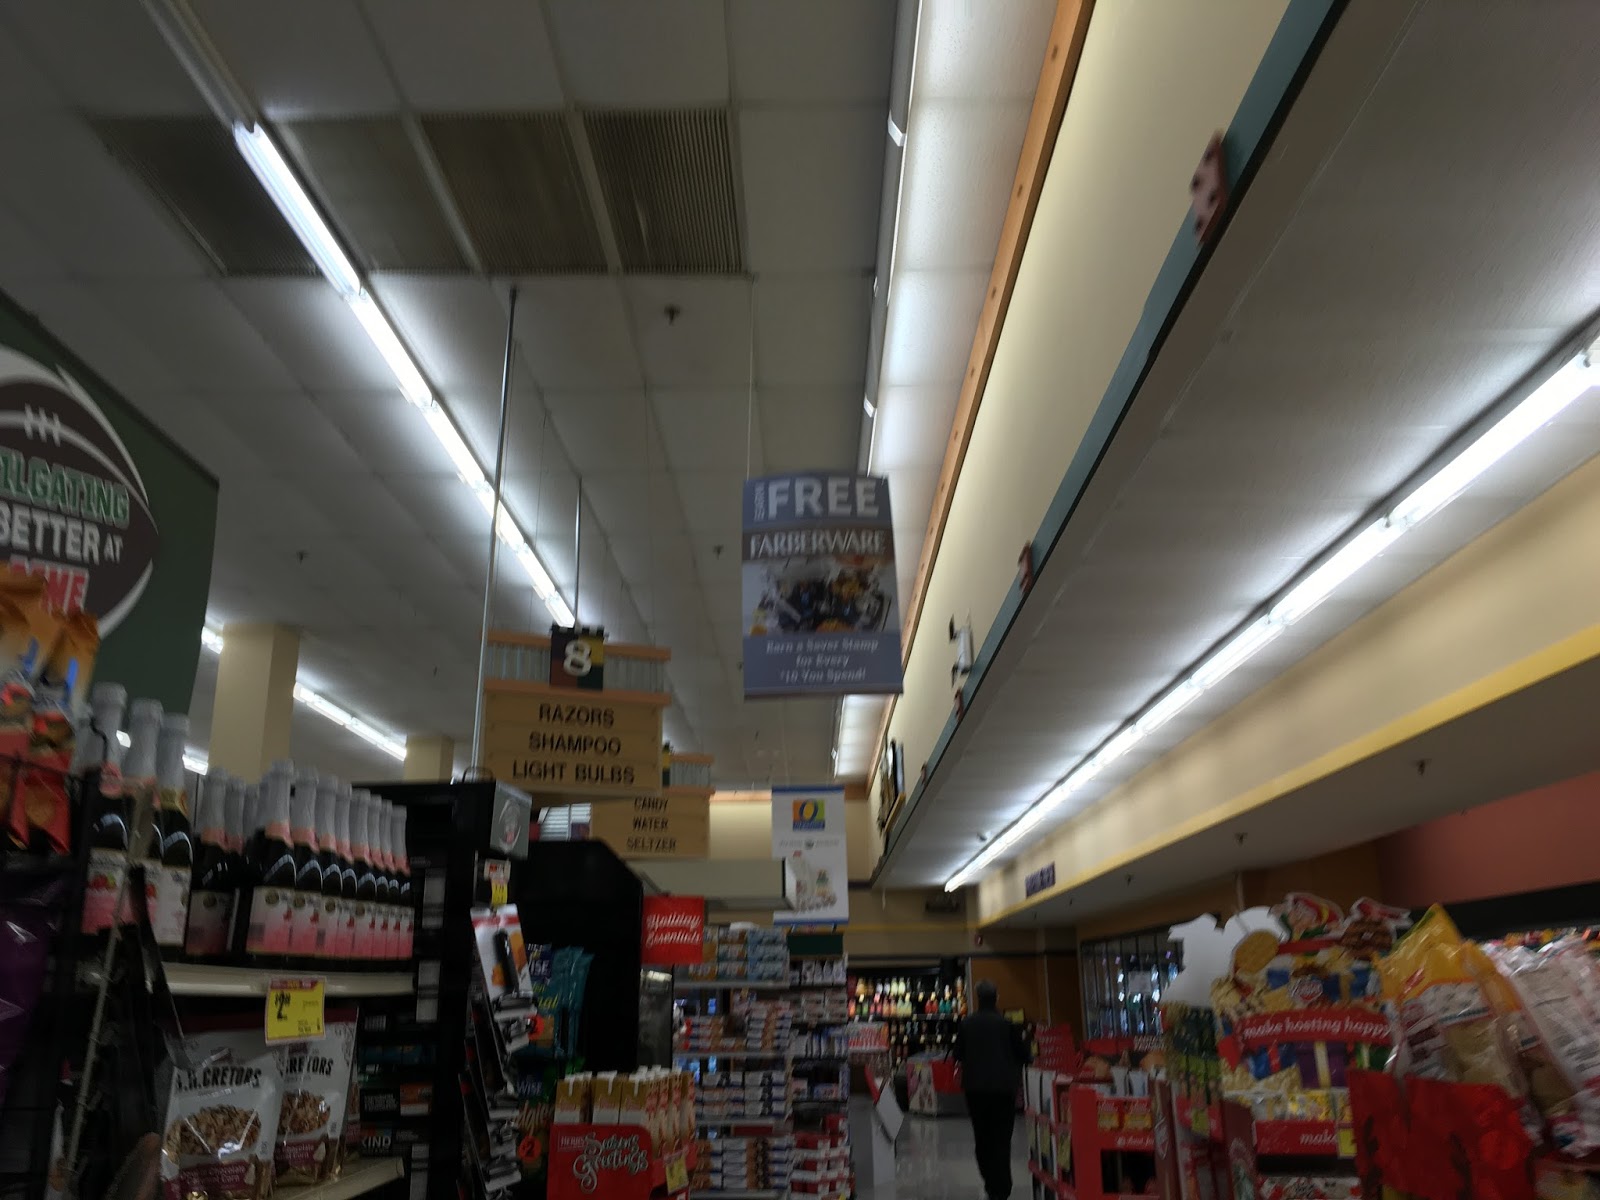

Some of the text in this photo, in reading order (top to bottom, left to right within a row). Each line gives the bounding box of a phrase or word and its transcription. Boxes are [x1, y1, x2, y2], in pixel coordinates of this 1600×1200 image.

[768, 476, 879, 520] FREE
[104, 533, 123, 563] AT
[563, 639, 593, 677] 8
[538, 702, 615, 729] RAZORS
[528, 731, 622, 757] SHAMPOO
[512, 759, 635, 785] LIGHT BULBS
[634, 796, 669, 812] CANDY
[632, 815, 669, 832] WATER
[626, 836, 677, 853] SELTZER
[646, 911, 702, 930] Holiday
[1284, 1016, 1342, 1035] hosting
